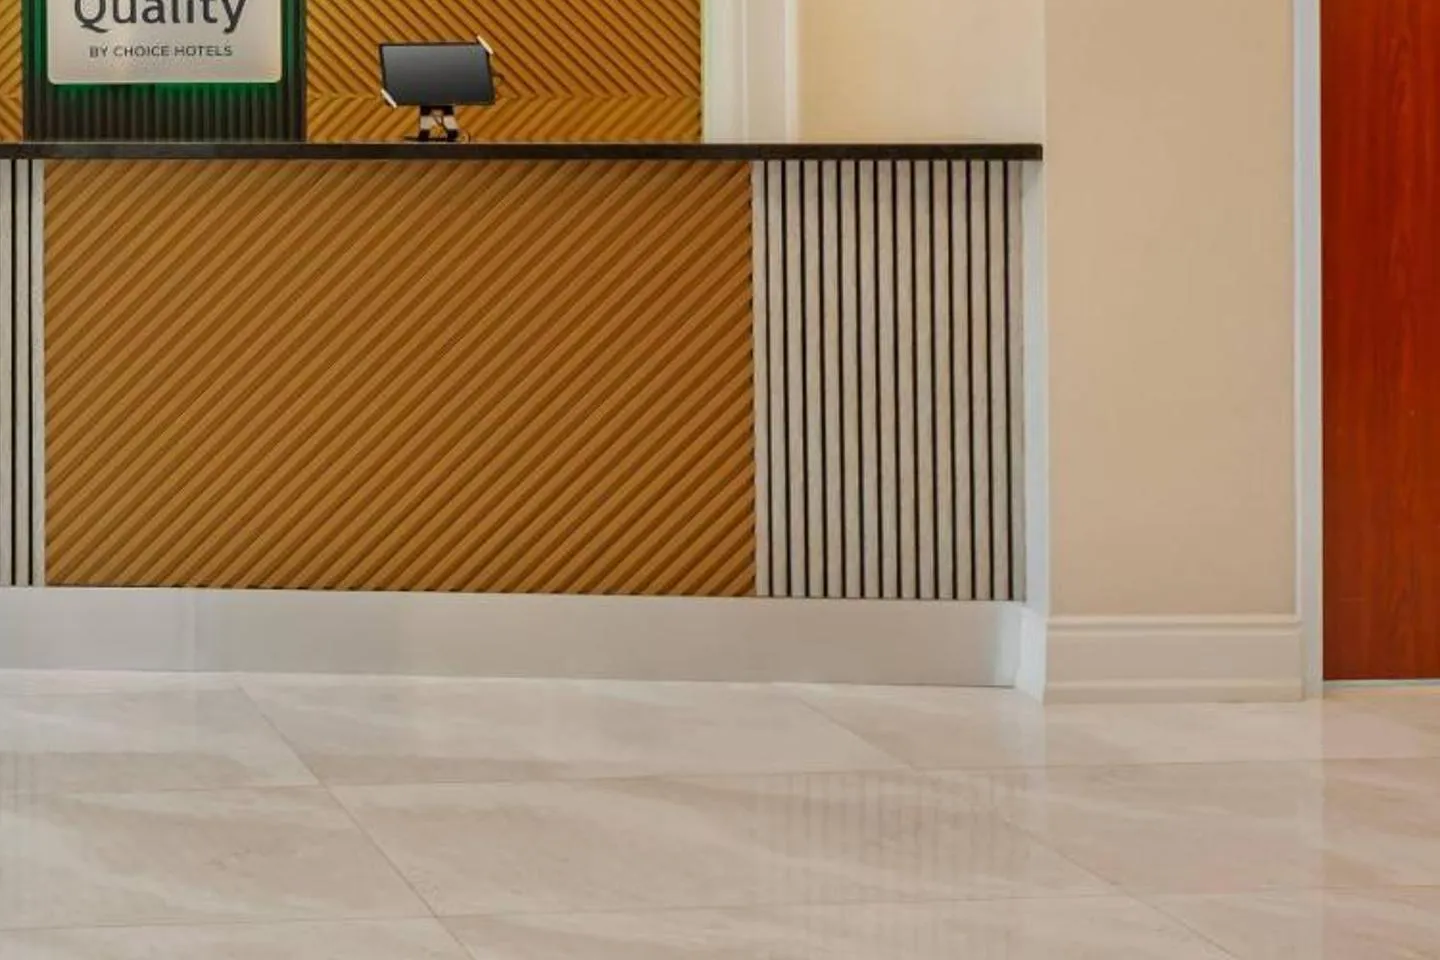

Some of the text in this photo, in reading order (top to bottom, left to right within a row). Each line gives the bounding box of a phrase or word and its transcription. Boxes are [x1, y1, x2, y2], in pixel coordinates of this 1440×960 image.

[89, 44, 233, 58] BY CHOICE HOTELS
